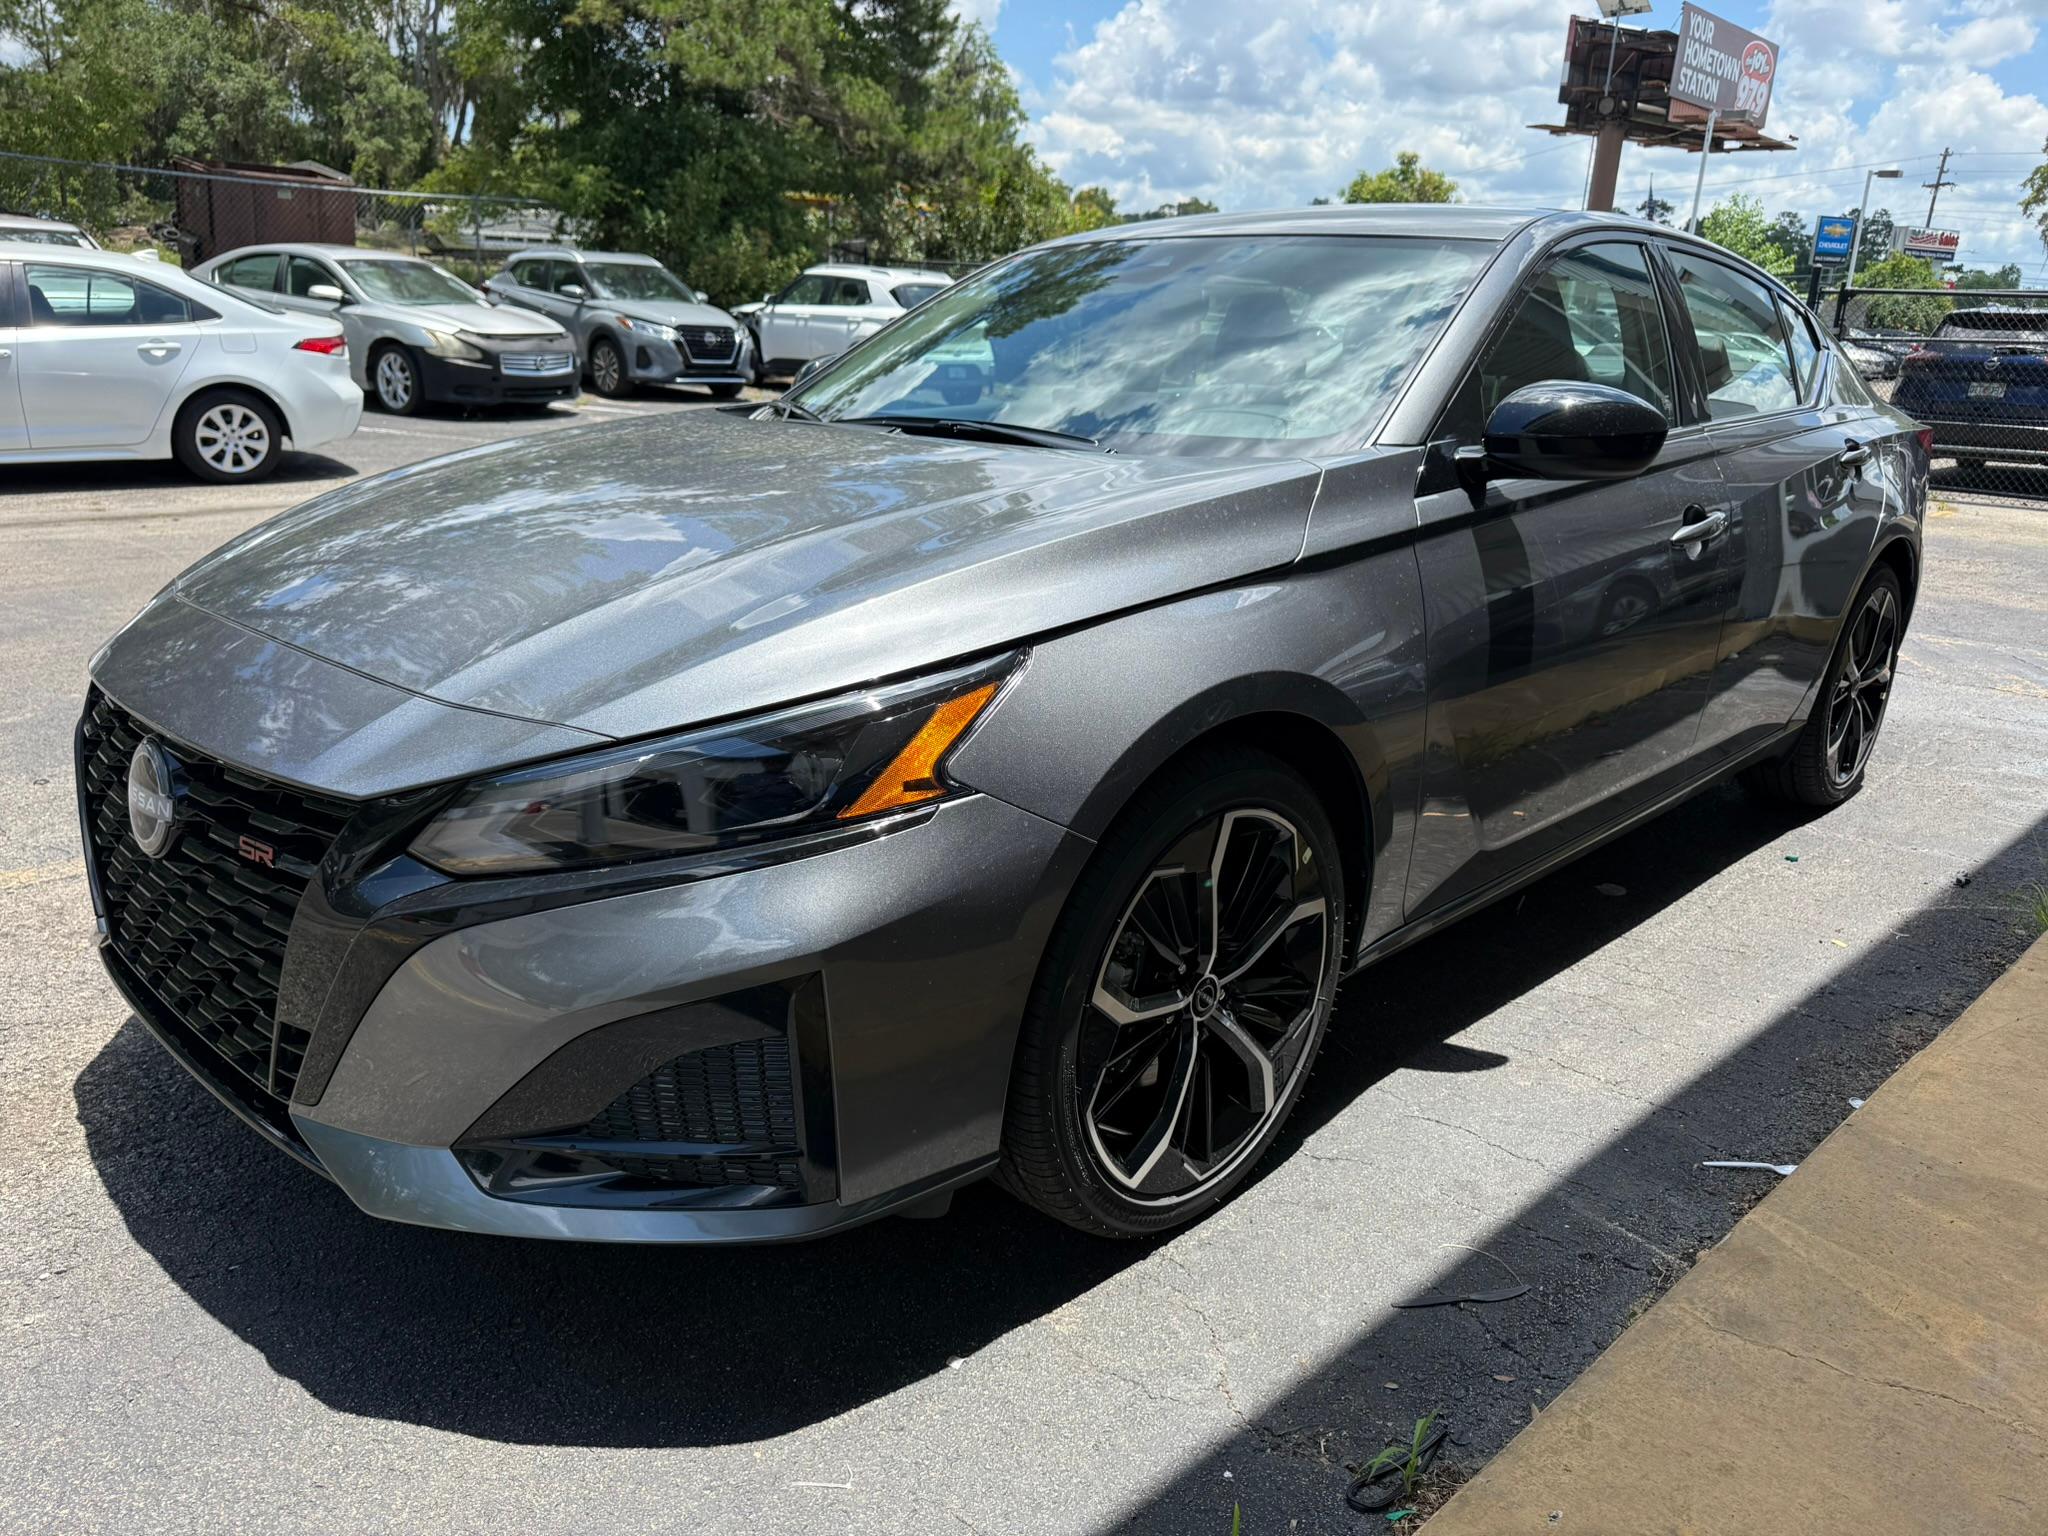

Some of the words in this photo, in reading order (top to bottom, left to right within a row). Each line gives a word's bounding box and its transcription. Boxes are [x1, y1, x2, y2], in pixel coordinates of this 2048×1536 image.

[1689, 11, 1715, 45] YOUR
[1683, 38, 1741, 83] HOMETOWN
[1678, 66, 1721, 104] STATION
[1818, 241, 1848, 249] CHEVROLET
[239, 835, 274, 868] SR
